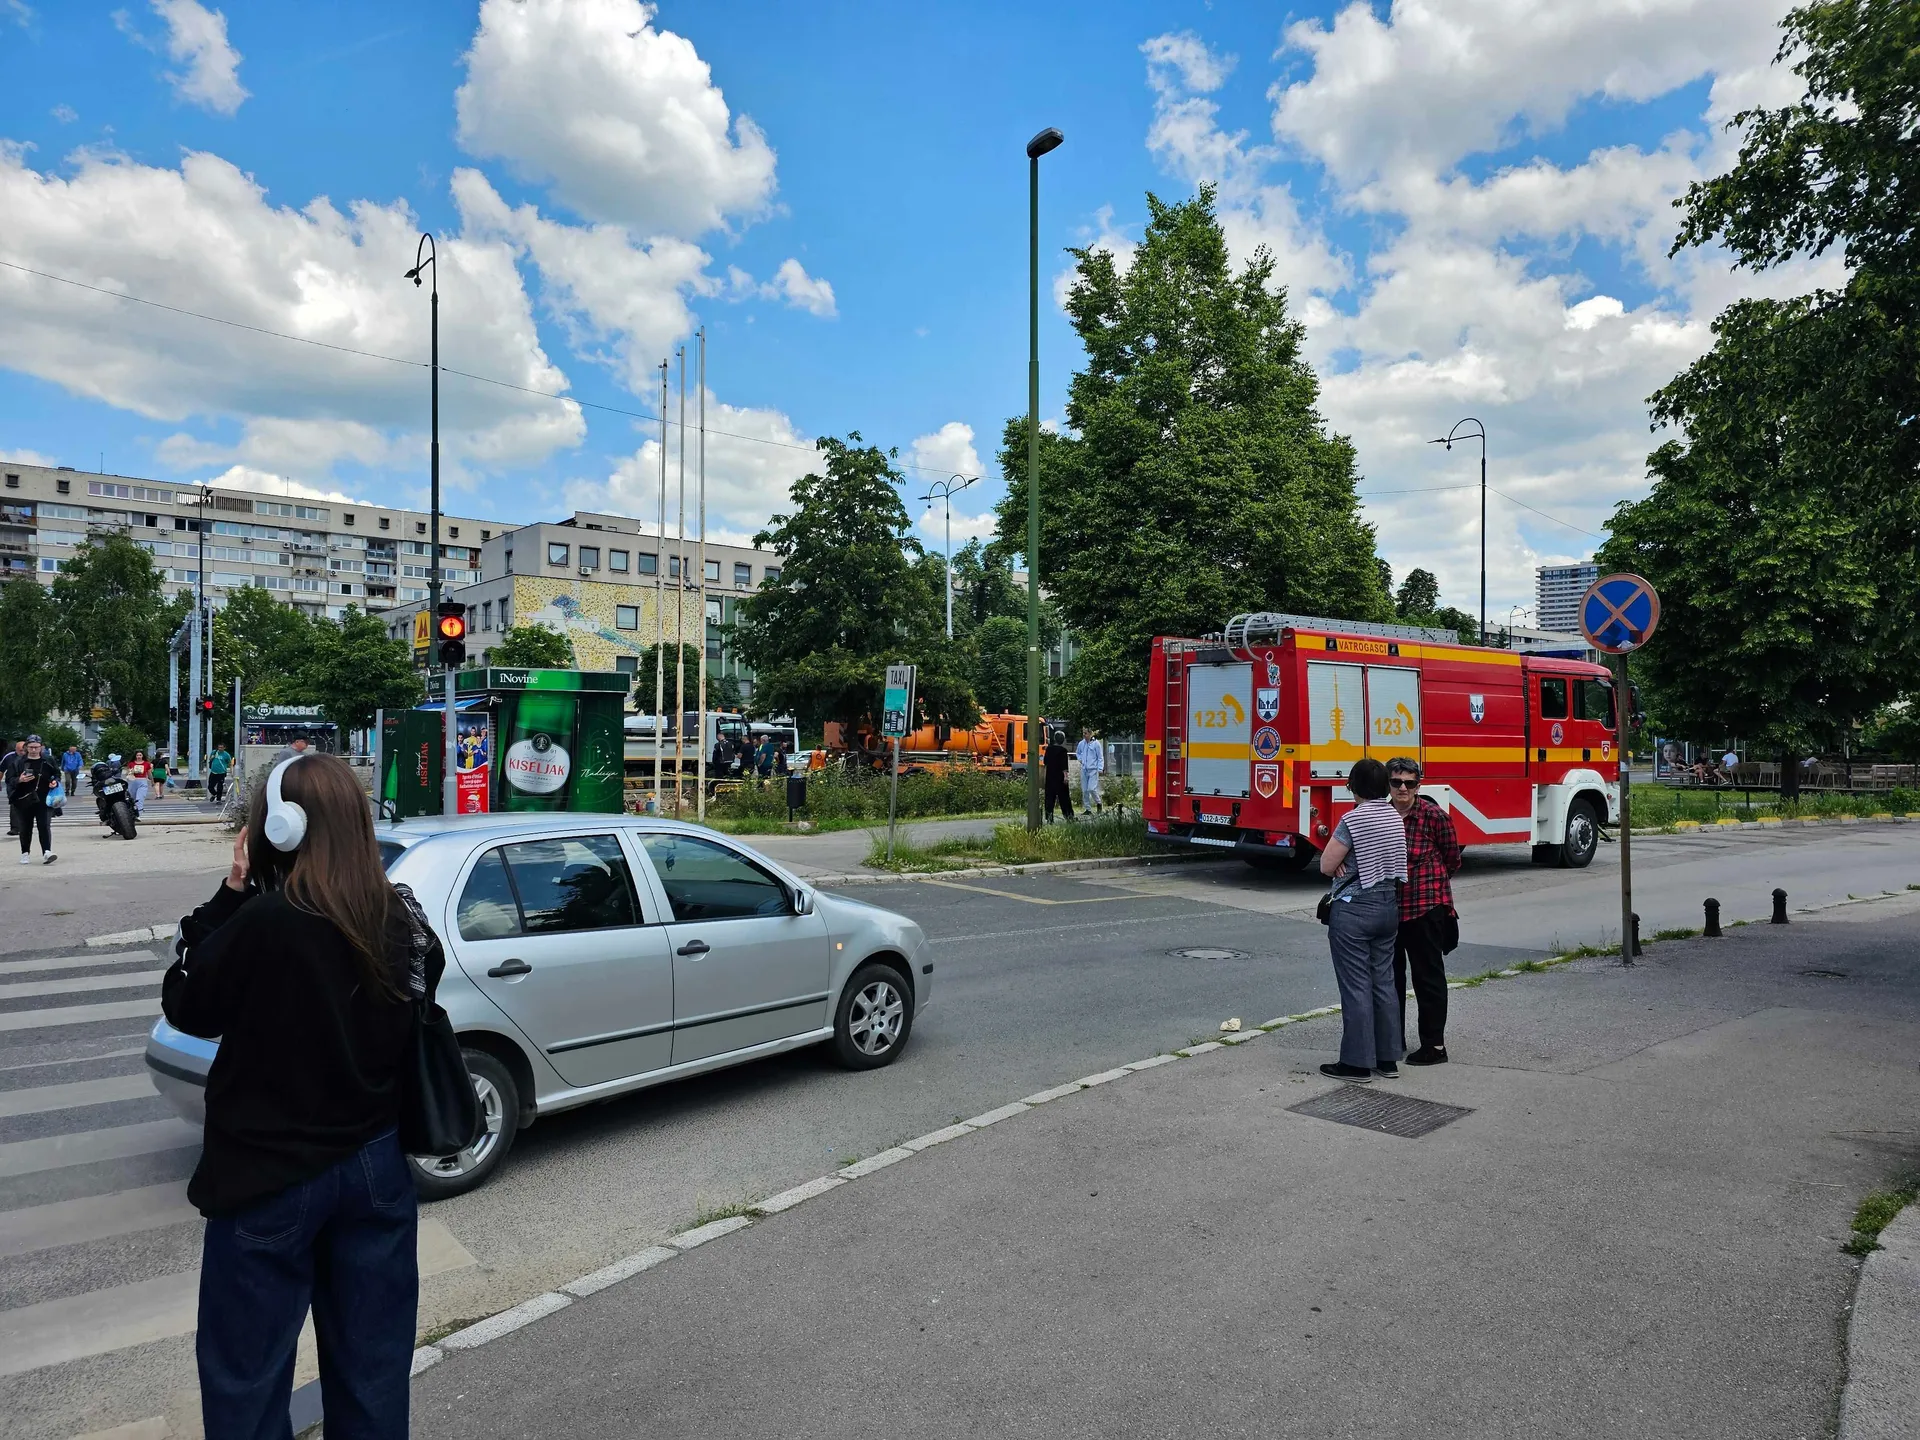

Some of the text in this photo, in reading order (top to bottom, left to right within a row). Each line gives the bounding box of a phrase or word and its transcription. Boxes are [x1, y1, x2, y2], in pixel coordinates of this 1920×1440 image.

[1338, 641, 1387, 654] VATROGASCI
[891, 670, 905, 685] TAXI
[1194, 710, 1228, 728] 123
[1374, 717, 1401, 735] 123
[421, 742, 429, 787] KISELJAK
[509, 757, 566, 777] KISELJAK
